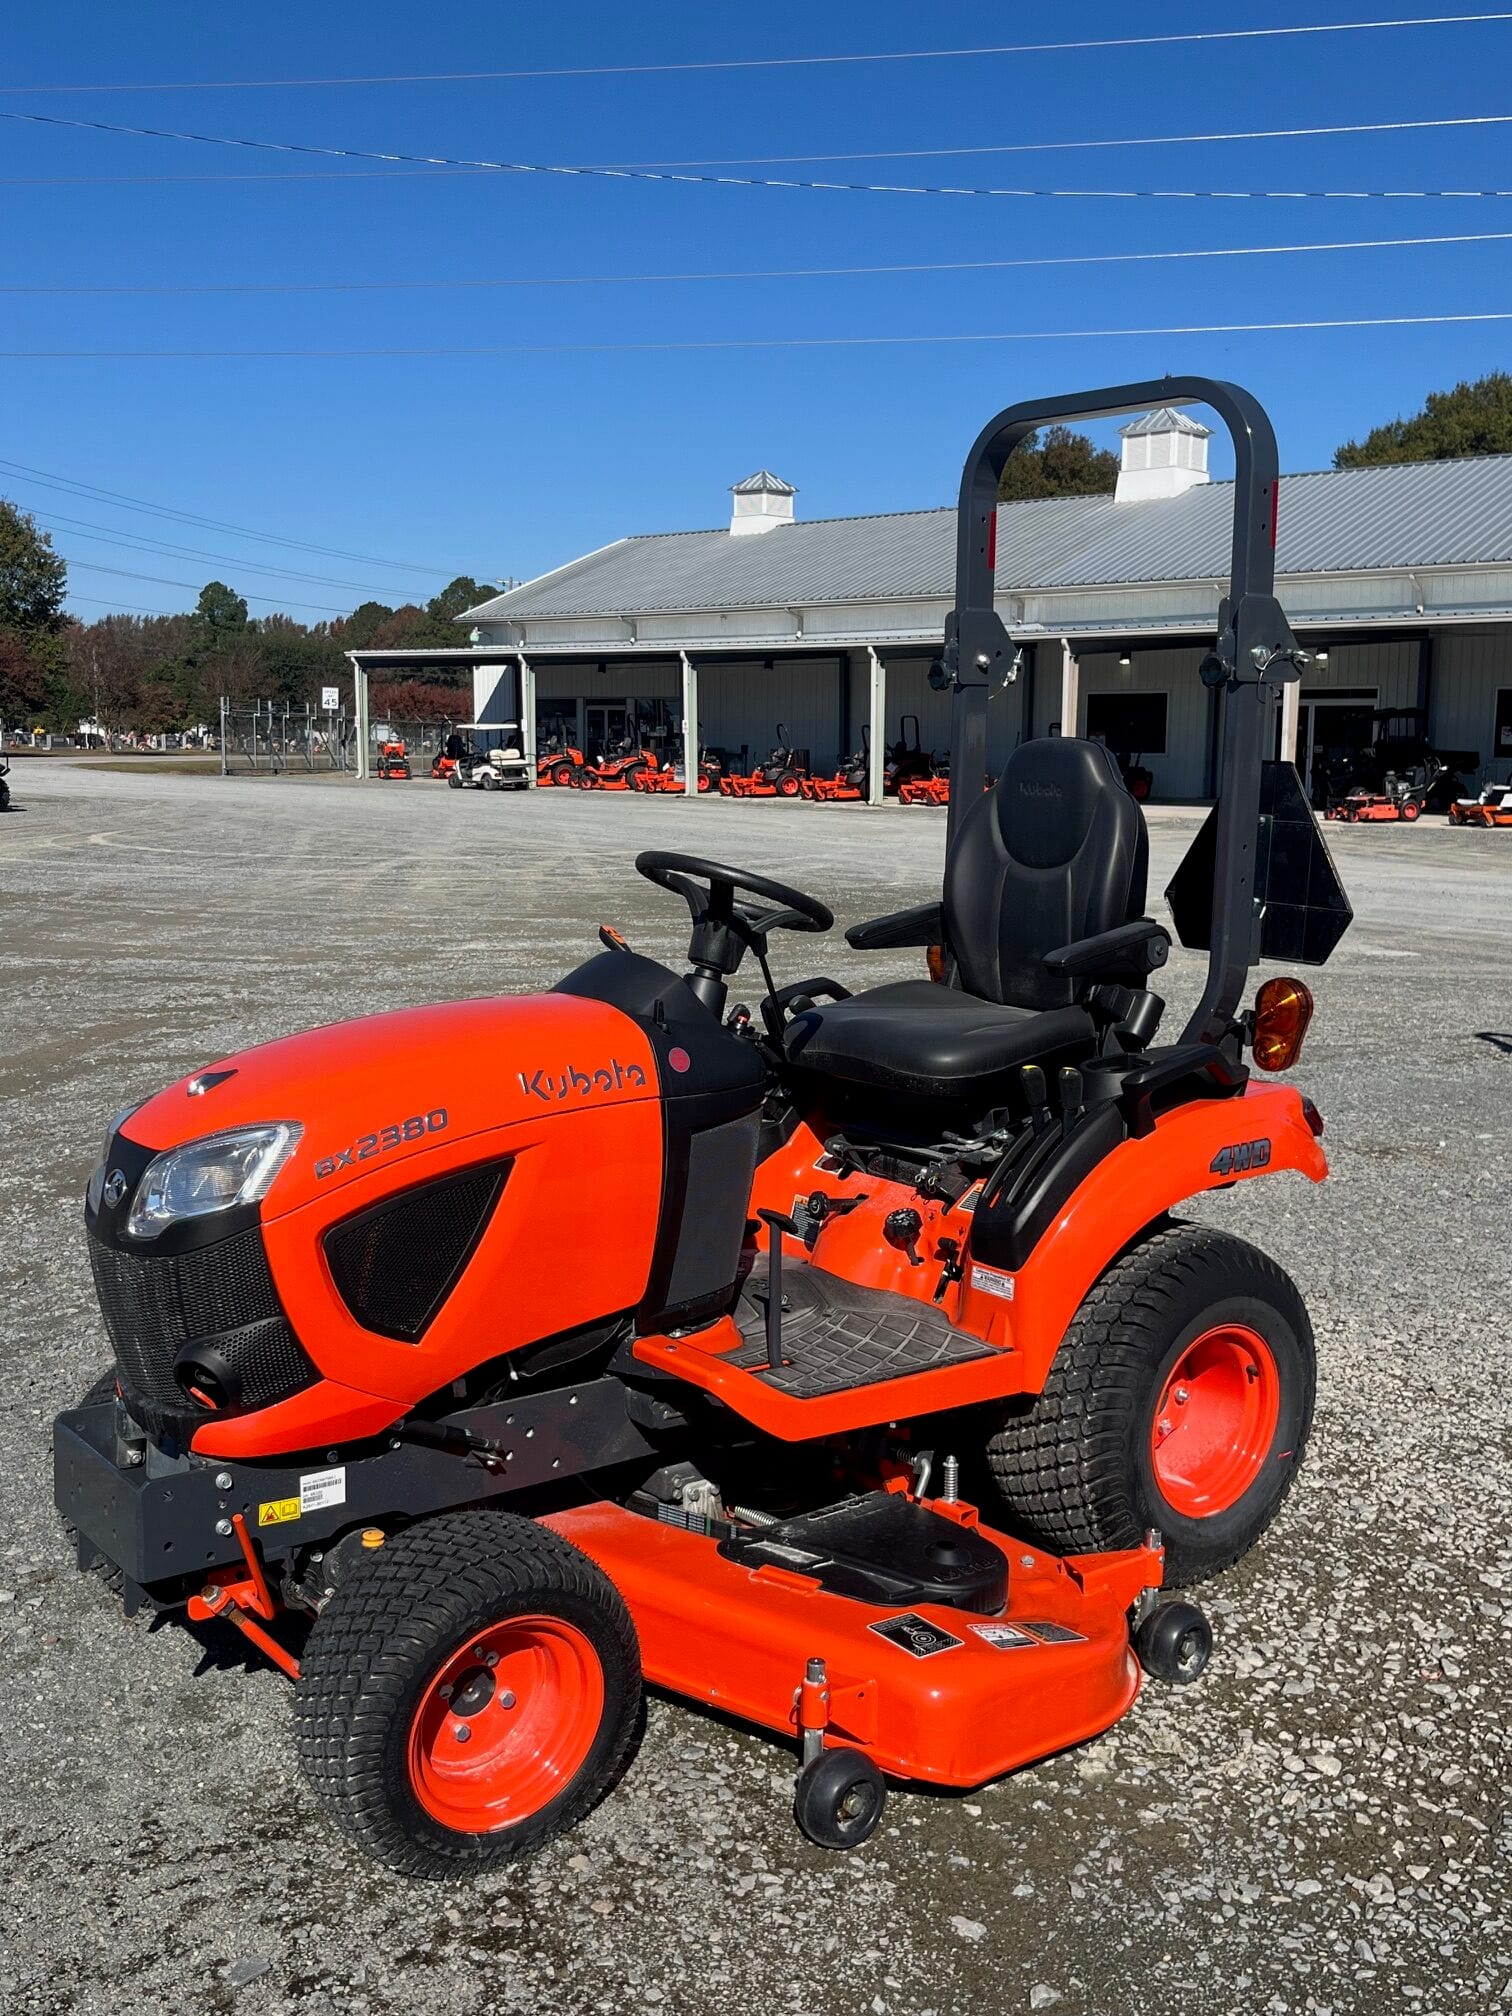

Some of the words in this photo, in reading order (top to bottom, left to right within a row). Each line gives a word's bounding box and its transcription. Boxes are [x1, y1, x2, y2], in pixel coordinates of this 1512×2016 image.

[324, 699, 337, 707] 45
[518, 1059, 646, 1101] Kubota
[314, 1108, 448, 1180] BX2380
[1210, 1138, 1271, 1176] 4WD
